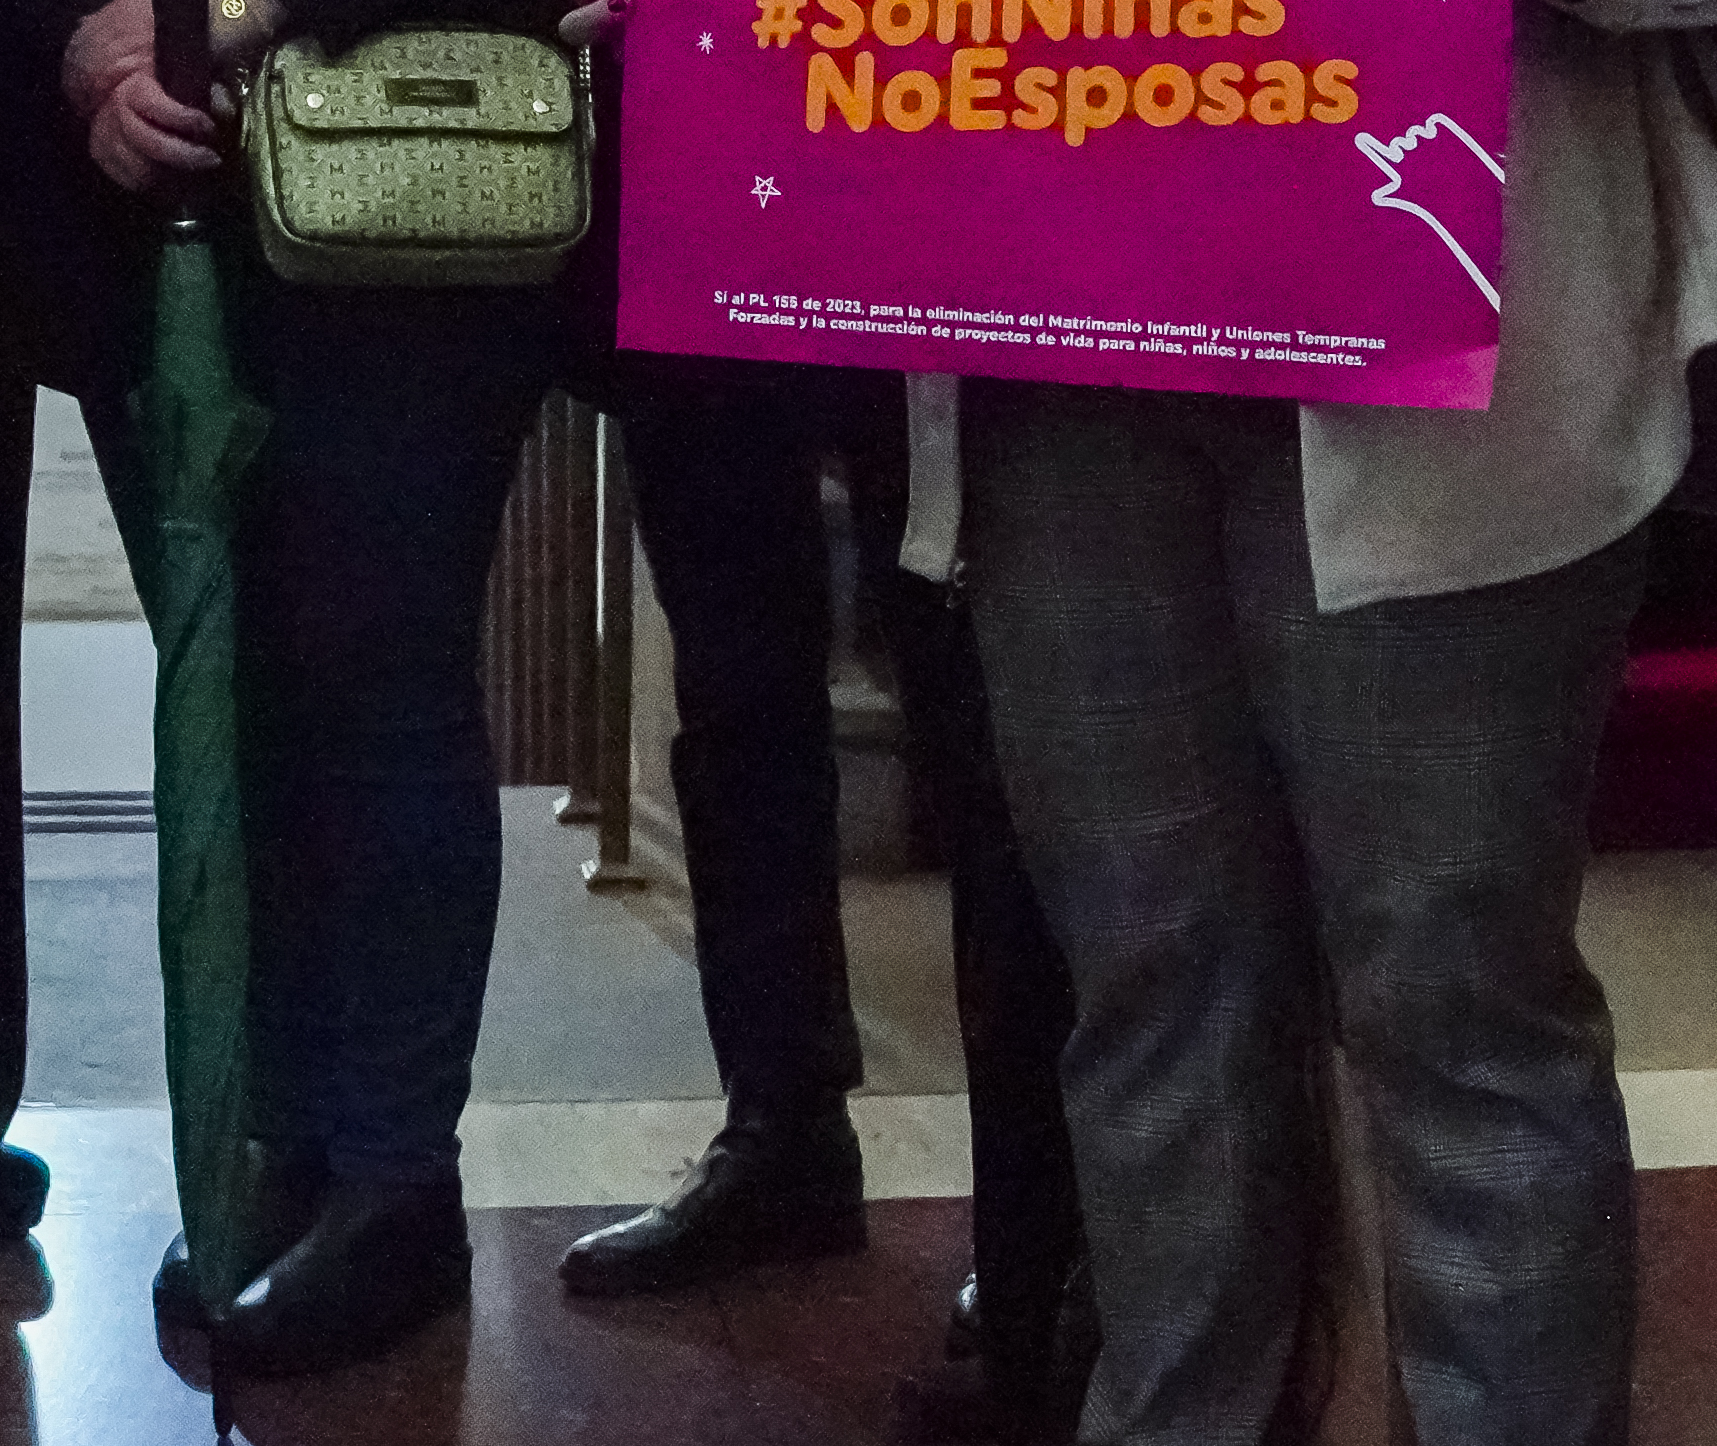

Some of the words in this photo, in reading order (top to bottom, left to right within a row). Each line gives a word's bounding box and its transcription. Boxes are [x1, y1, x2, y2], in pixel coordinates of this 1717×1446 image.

[805, 46, 1358, 147] NoEsposas
[729, 309, 796, 326] Forzadas
[799, 316, 808, 330] y
[812, 315, 826, 329] la
[829, 319, 927, 336] construcción
[931, 324, 950, 338] de
[955, 327, 1031, 344] proyectos
[1036, 332, 1056, 345] de
[1061, 332, 1094, 348] vida
[1099, 338, 1135, 351] para
[1140, 338, 1187, 356] niñas,
[1192, 342, 1236, 358] niños
[1240, 347, 1249, 360] y
[1255, 347, 1367, 366] adolescentes.
[731, 292, 744, 305] al
[749, 293, 768, 307] PL
[803, 297, 822, 310] de
[826, 298, 865, 315] 2023,
[870, 304, 903, 317] para
[908, 305, 922, 318] la
[926, 306, 1014, 325] eliminación
[1019, 313, 1044, 327] del
[1049, 314, 1143, 333] Matrimonio
[1147, 321, 1207, 338] Infantil
[1211, 328, 1220, 341] y
[1225, 326, 1291, 343] Uniones
[1296, 330, 1386, 349] Tempranas
